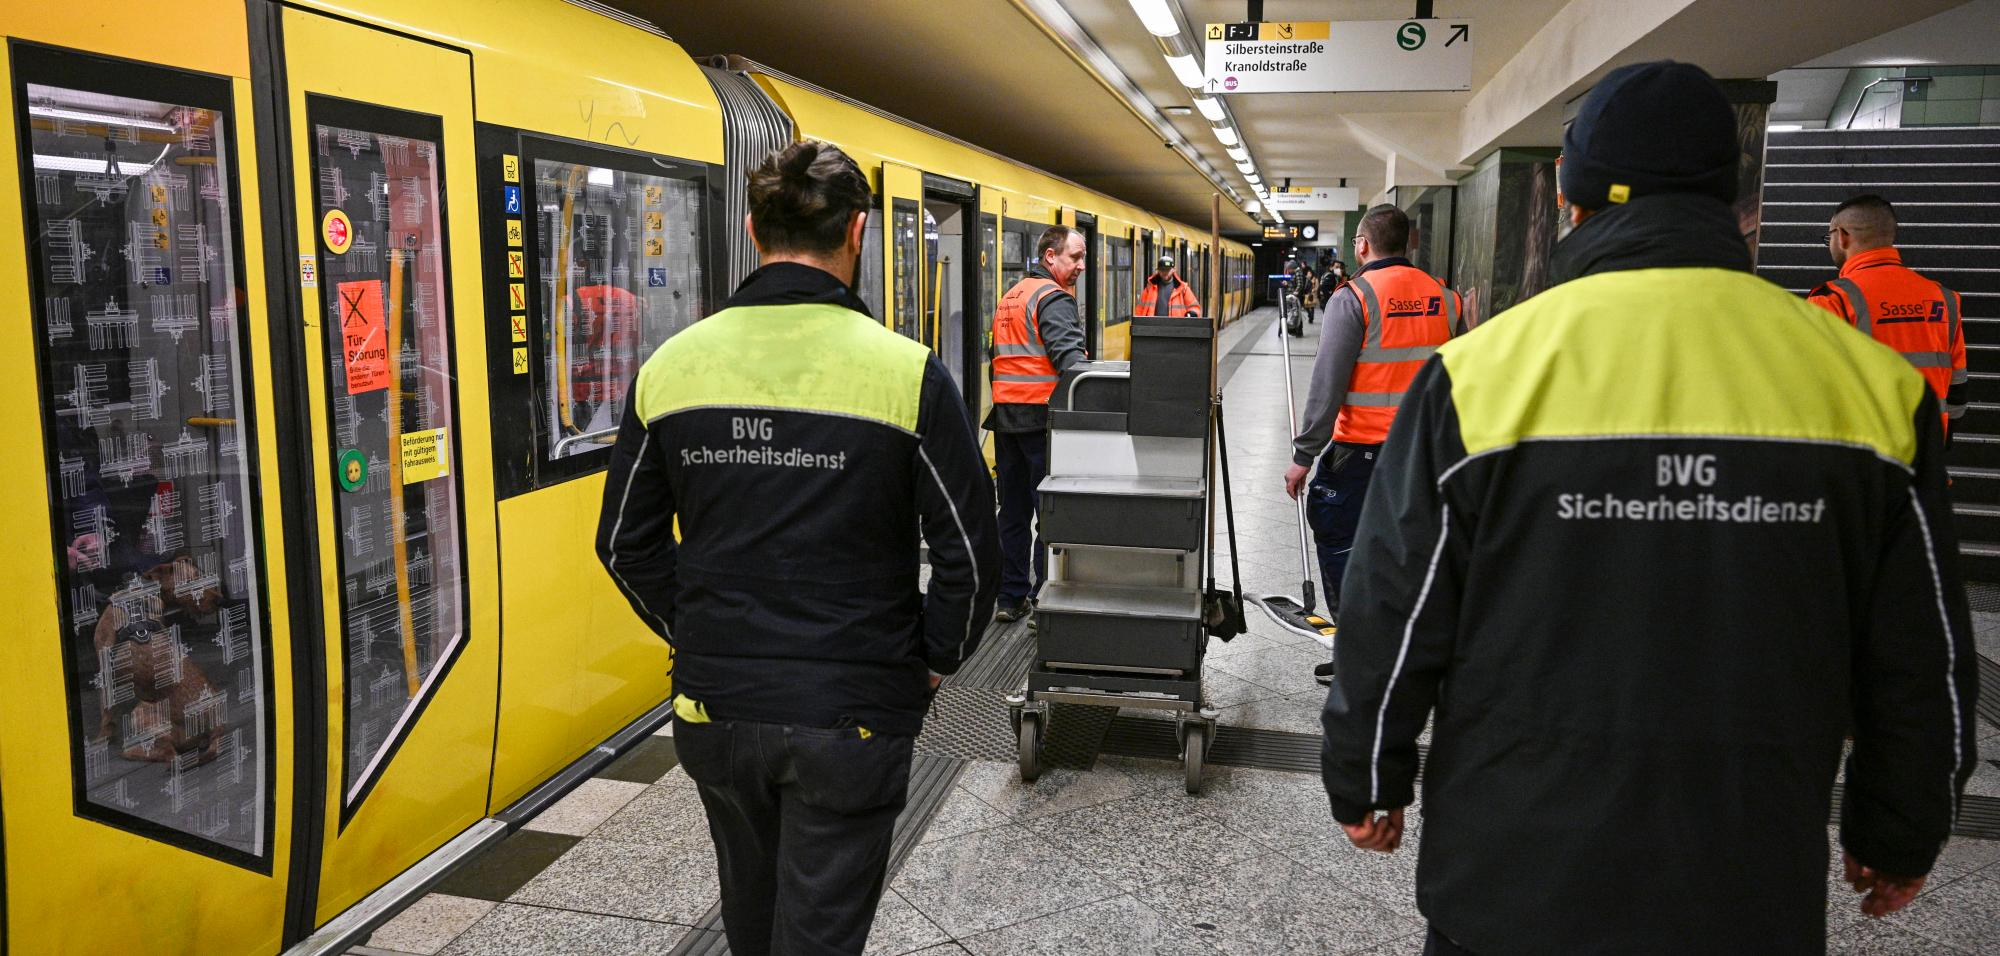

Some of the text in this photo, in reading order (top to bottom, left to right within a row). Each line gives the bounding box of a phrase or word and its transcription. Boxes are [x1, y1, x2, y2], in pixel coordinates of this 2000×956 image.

[1230, 27, 1236, 37] F
[1247, 26, 1253, 38] J
[1225, 42, 1324, 55] Silbersteinstraße
[1225, 60, 1307, 72] Kranoldstraße
[1388, 297, 1422, 311] Sasse
[1880, 301, 1924, 316] Sasse
[347, 334, 366, 347] Tür-
[732, 416, 773, 441] BVG
[403, 435, 435, 446] Beförderung
[403, 449, 413, 457] mit
[404, 455, 436, 468] Fahrausweis
[1656, 454, 1717, 487] BVG
[1557, 493, 1826, 523] Sicherheitsdienst
